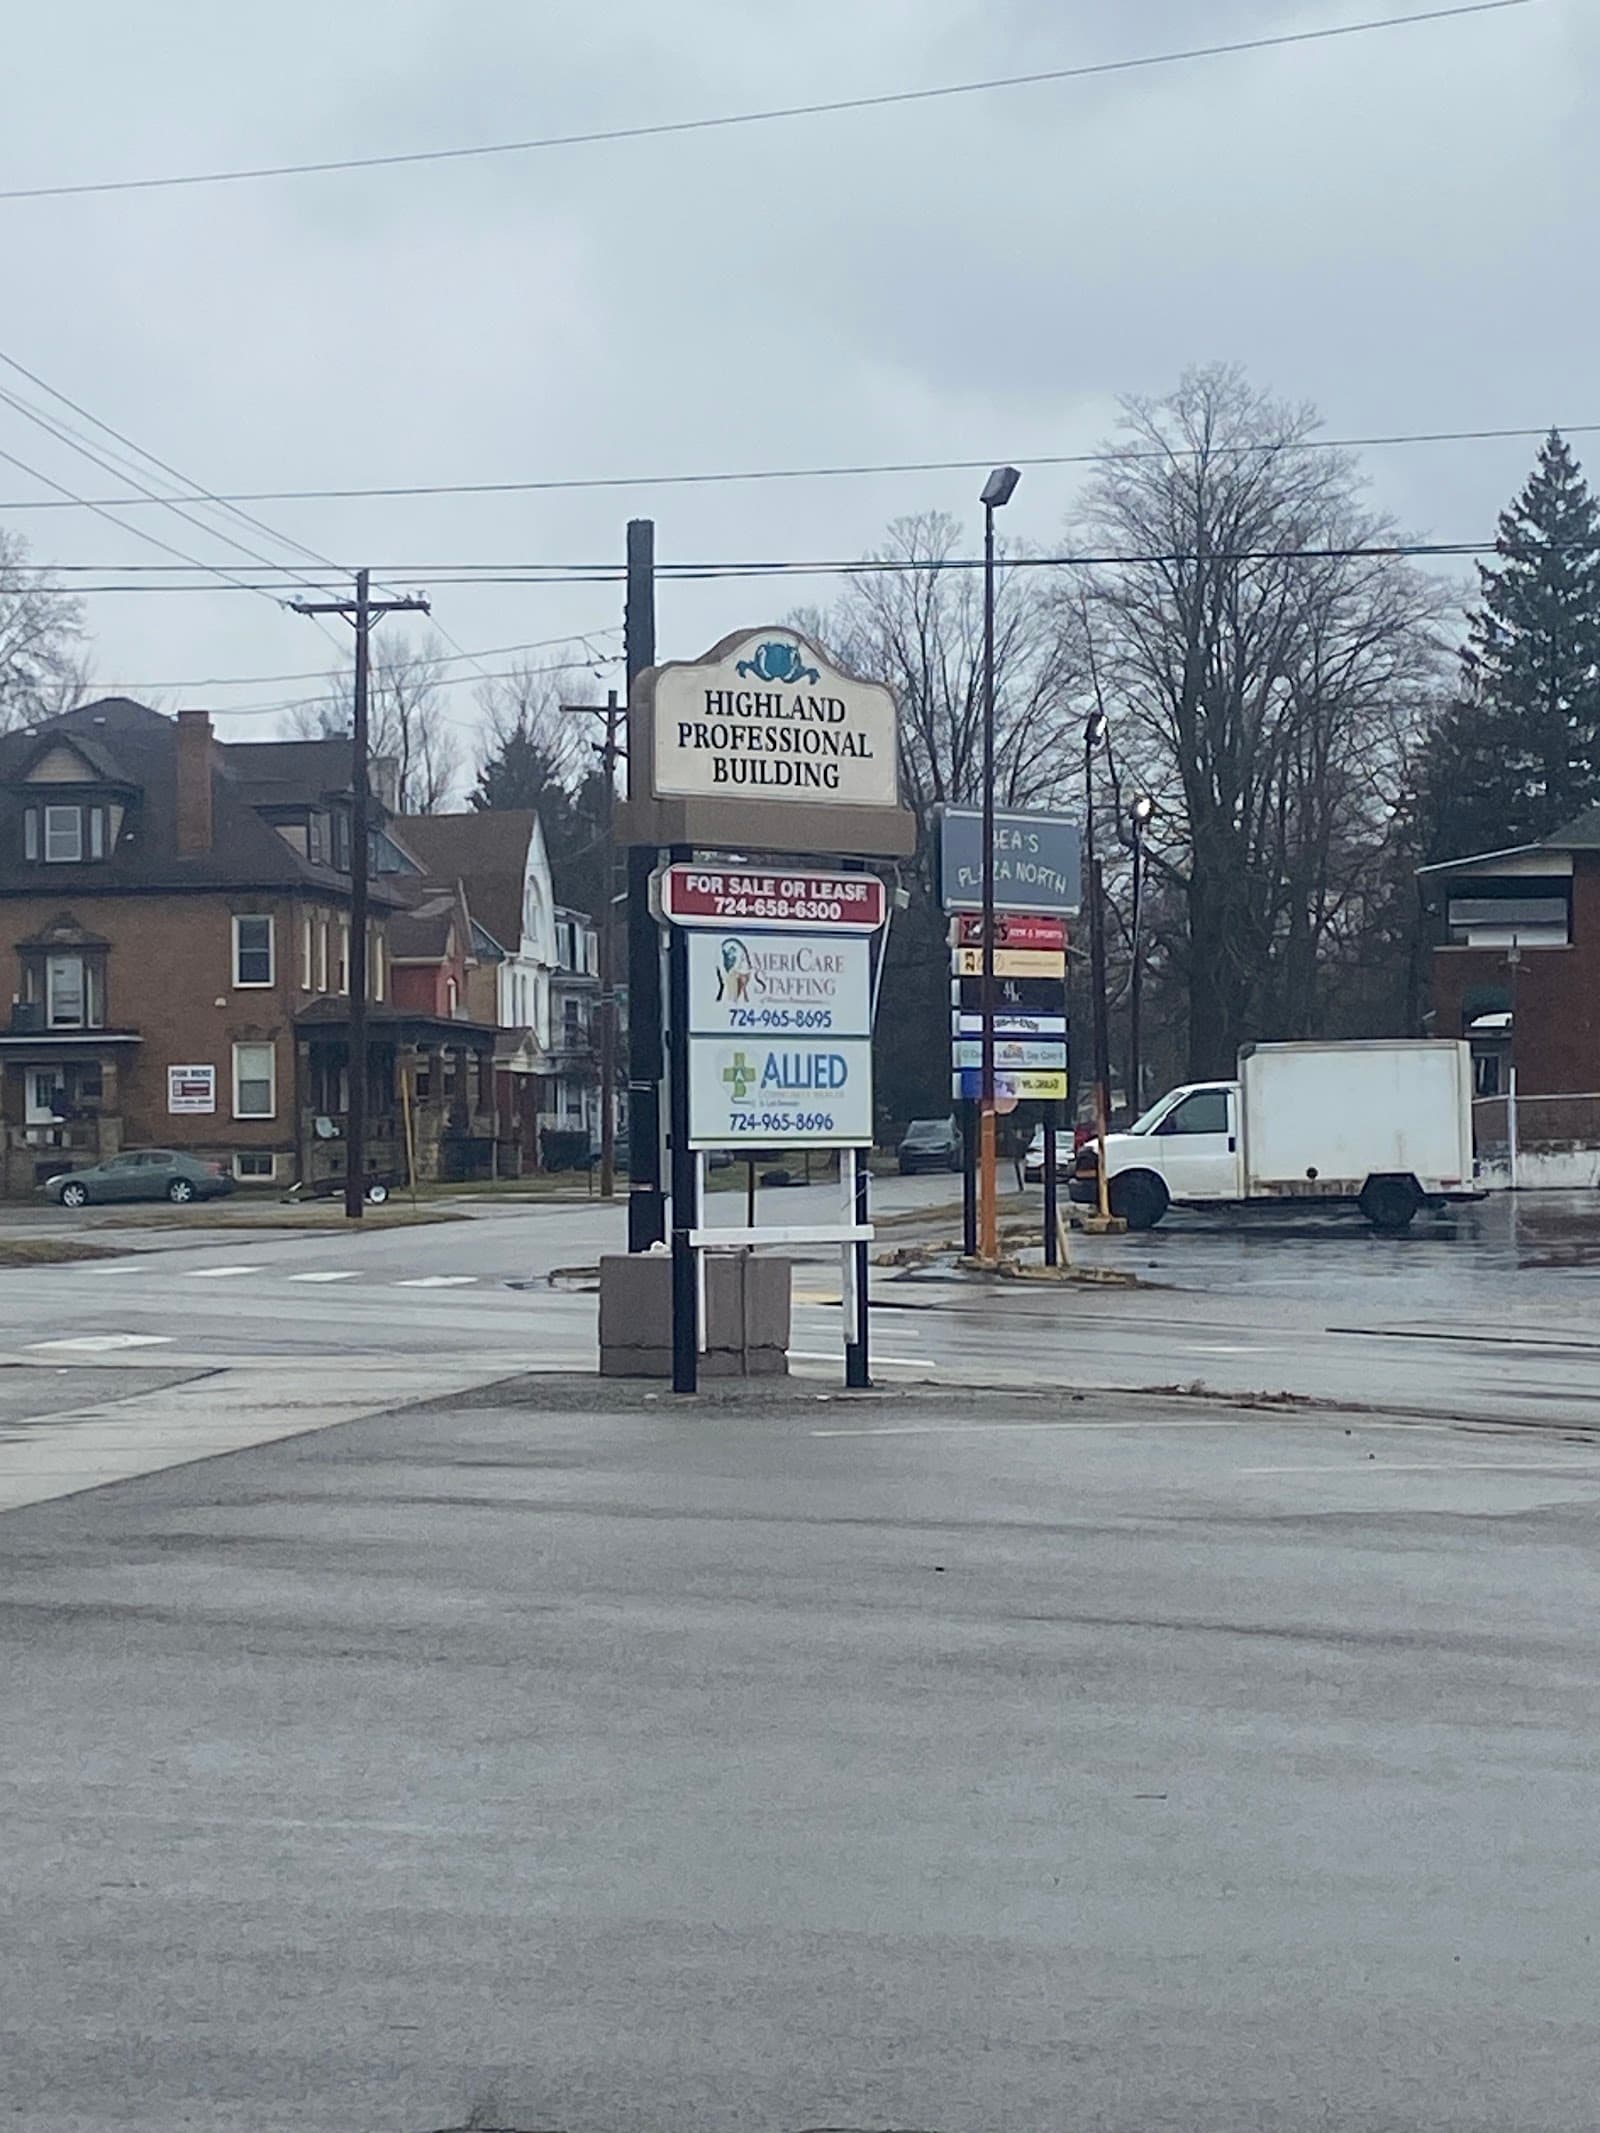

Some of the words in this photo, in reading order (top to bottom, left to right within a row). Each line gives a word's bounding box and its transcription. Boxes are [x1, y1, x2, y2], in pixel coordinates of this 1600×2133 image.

[704, 690, 845, 722] HIGHLAND
[678, 723, 873, 758] PROFESSIONAL
[713, 758, 840, 788] BUILDING
[686, 876, 723, 894] FOR
[728, 878, 775, 897] SALE
[781, 881, 806, 897] OR
[811, 882, 867, 901] LEASE
[1016, 862, 1066, 894] NORTH
[714, 897, 841, 920] 724-658-6300
[754, 971, 835, 995] STAFFING
[729, 1010, 831, 1028] 724-965-8695
[761, 1052, 848, 1089] ALLIED
[730, 1114, 833, 1131] 724-965-8696
